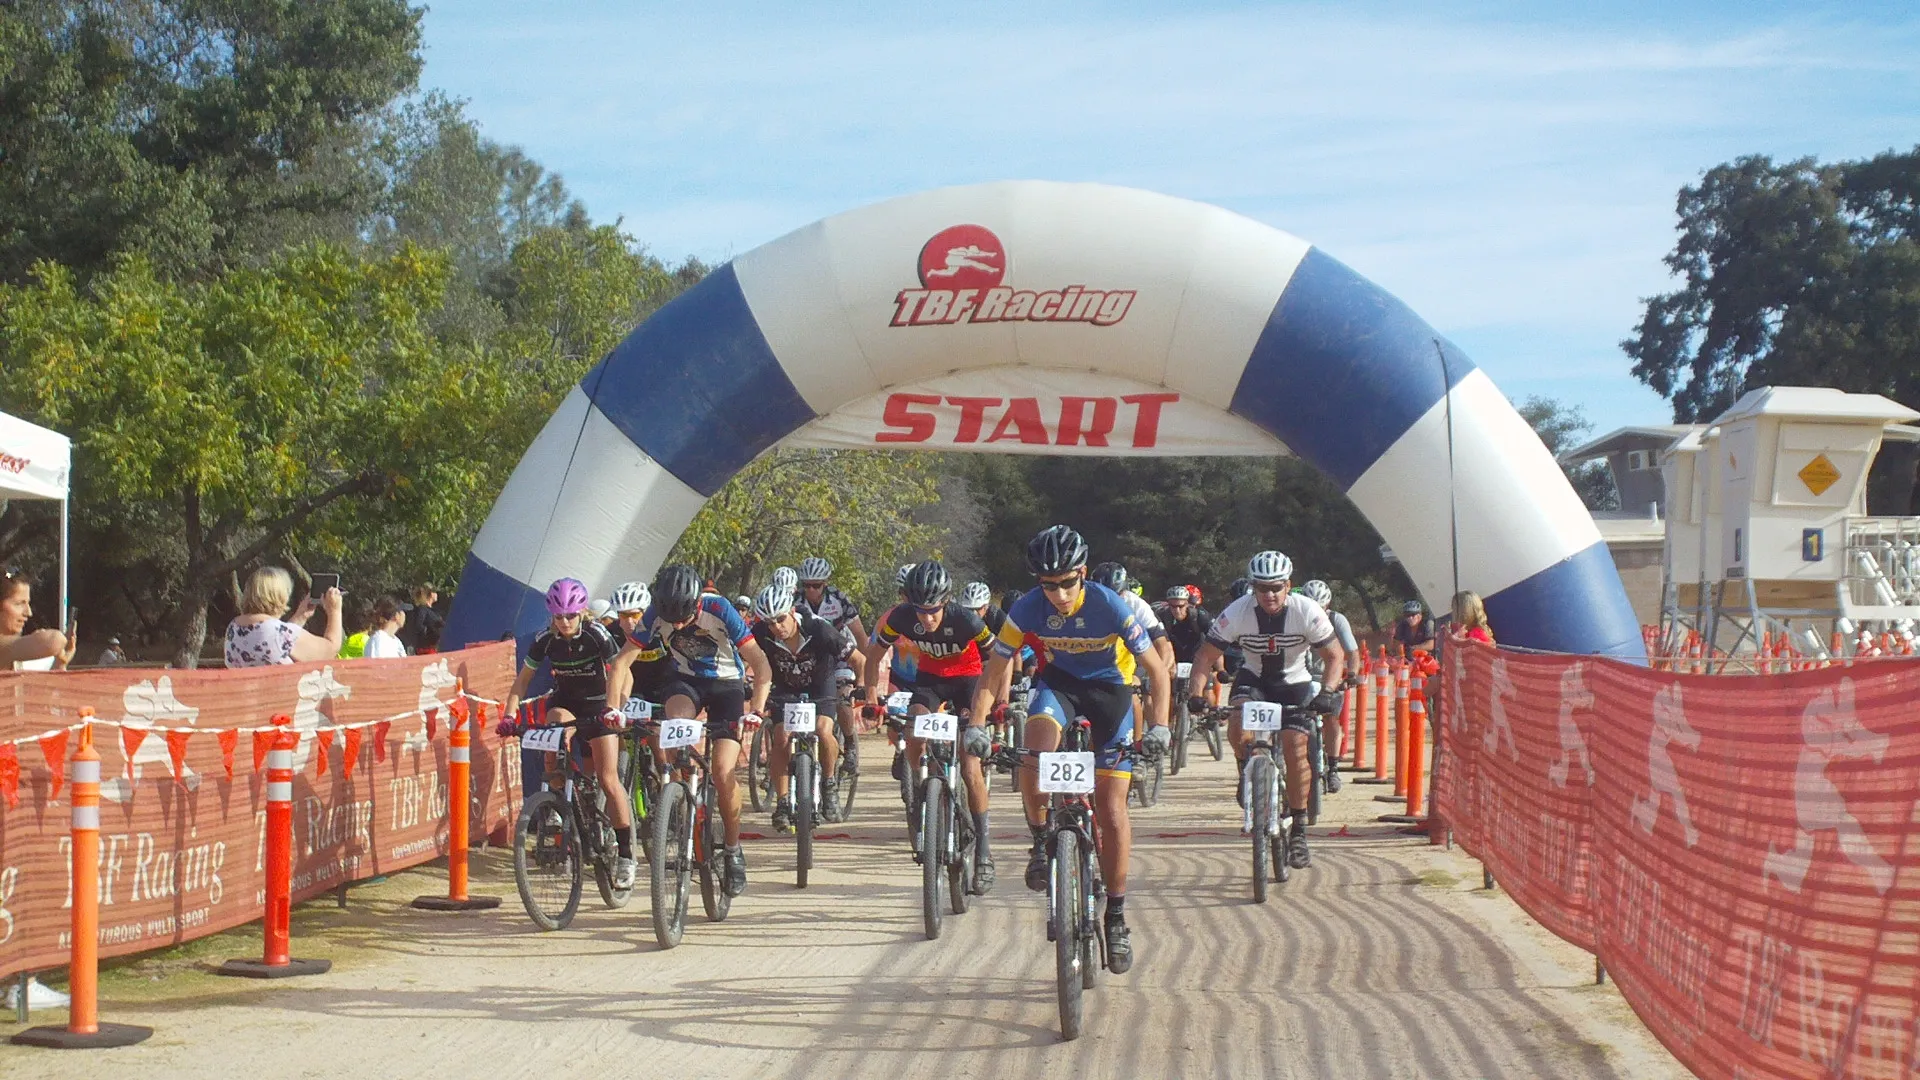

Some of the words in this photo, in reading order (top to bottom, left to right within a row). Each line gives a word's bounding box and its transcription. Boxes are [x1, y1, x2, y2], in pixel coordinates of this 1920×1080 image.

[889, 288, 980, 327] TBF
[968, 284, 1138, 327] Racing
[875, 392, 1180, 448] START
[1808, 533, 1819, 556] 1
[624, 700, 646, 713] 270
[1250, 708, 1275, 723] 367
[789, 710, 810, 725] 278
[922, 718, 950, 732] 264
[529, 728, 556, 743] 277
[667, 725, 693, 740] 265
[1050, 762, 1085, 782] 282
[390, 773, 425, 831] TBF
[304, 788, 372, 855] Racing
[131, 826, 225, 905] Racing
